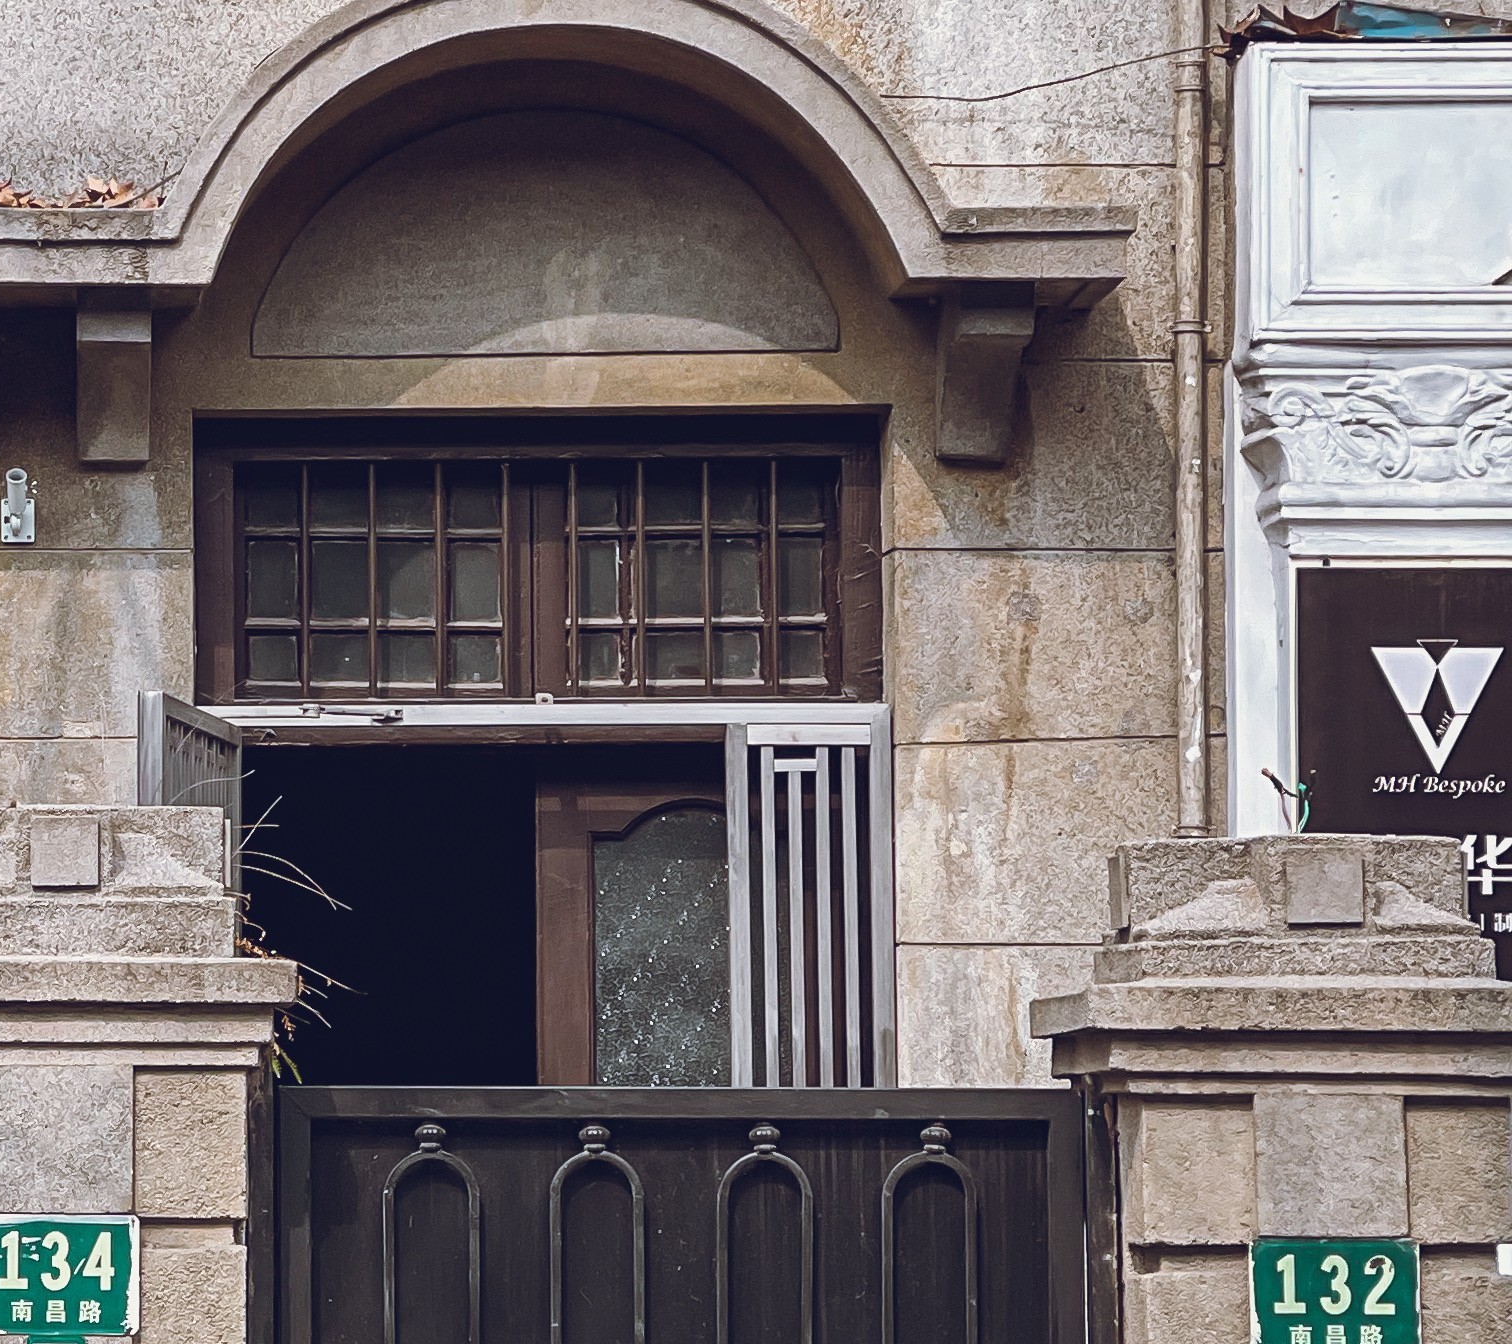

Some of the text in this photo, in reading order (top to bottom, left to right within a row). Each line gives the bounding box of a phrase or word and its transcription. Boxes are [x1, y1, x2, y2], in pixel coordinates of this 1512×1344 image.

[1372, 774, 1505, 799] MH Bespoke
[1274, 1254, 1396, 1316] 132
[10, 1299, 102, 1324] 南昌路
